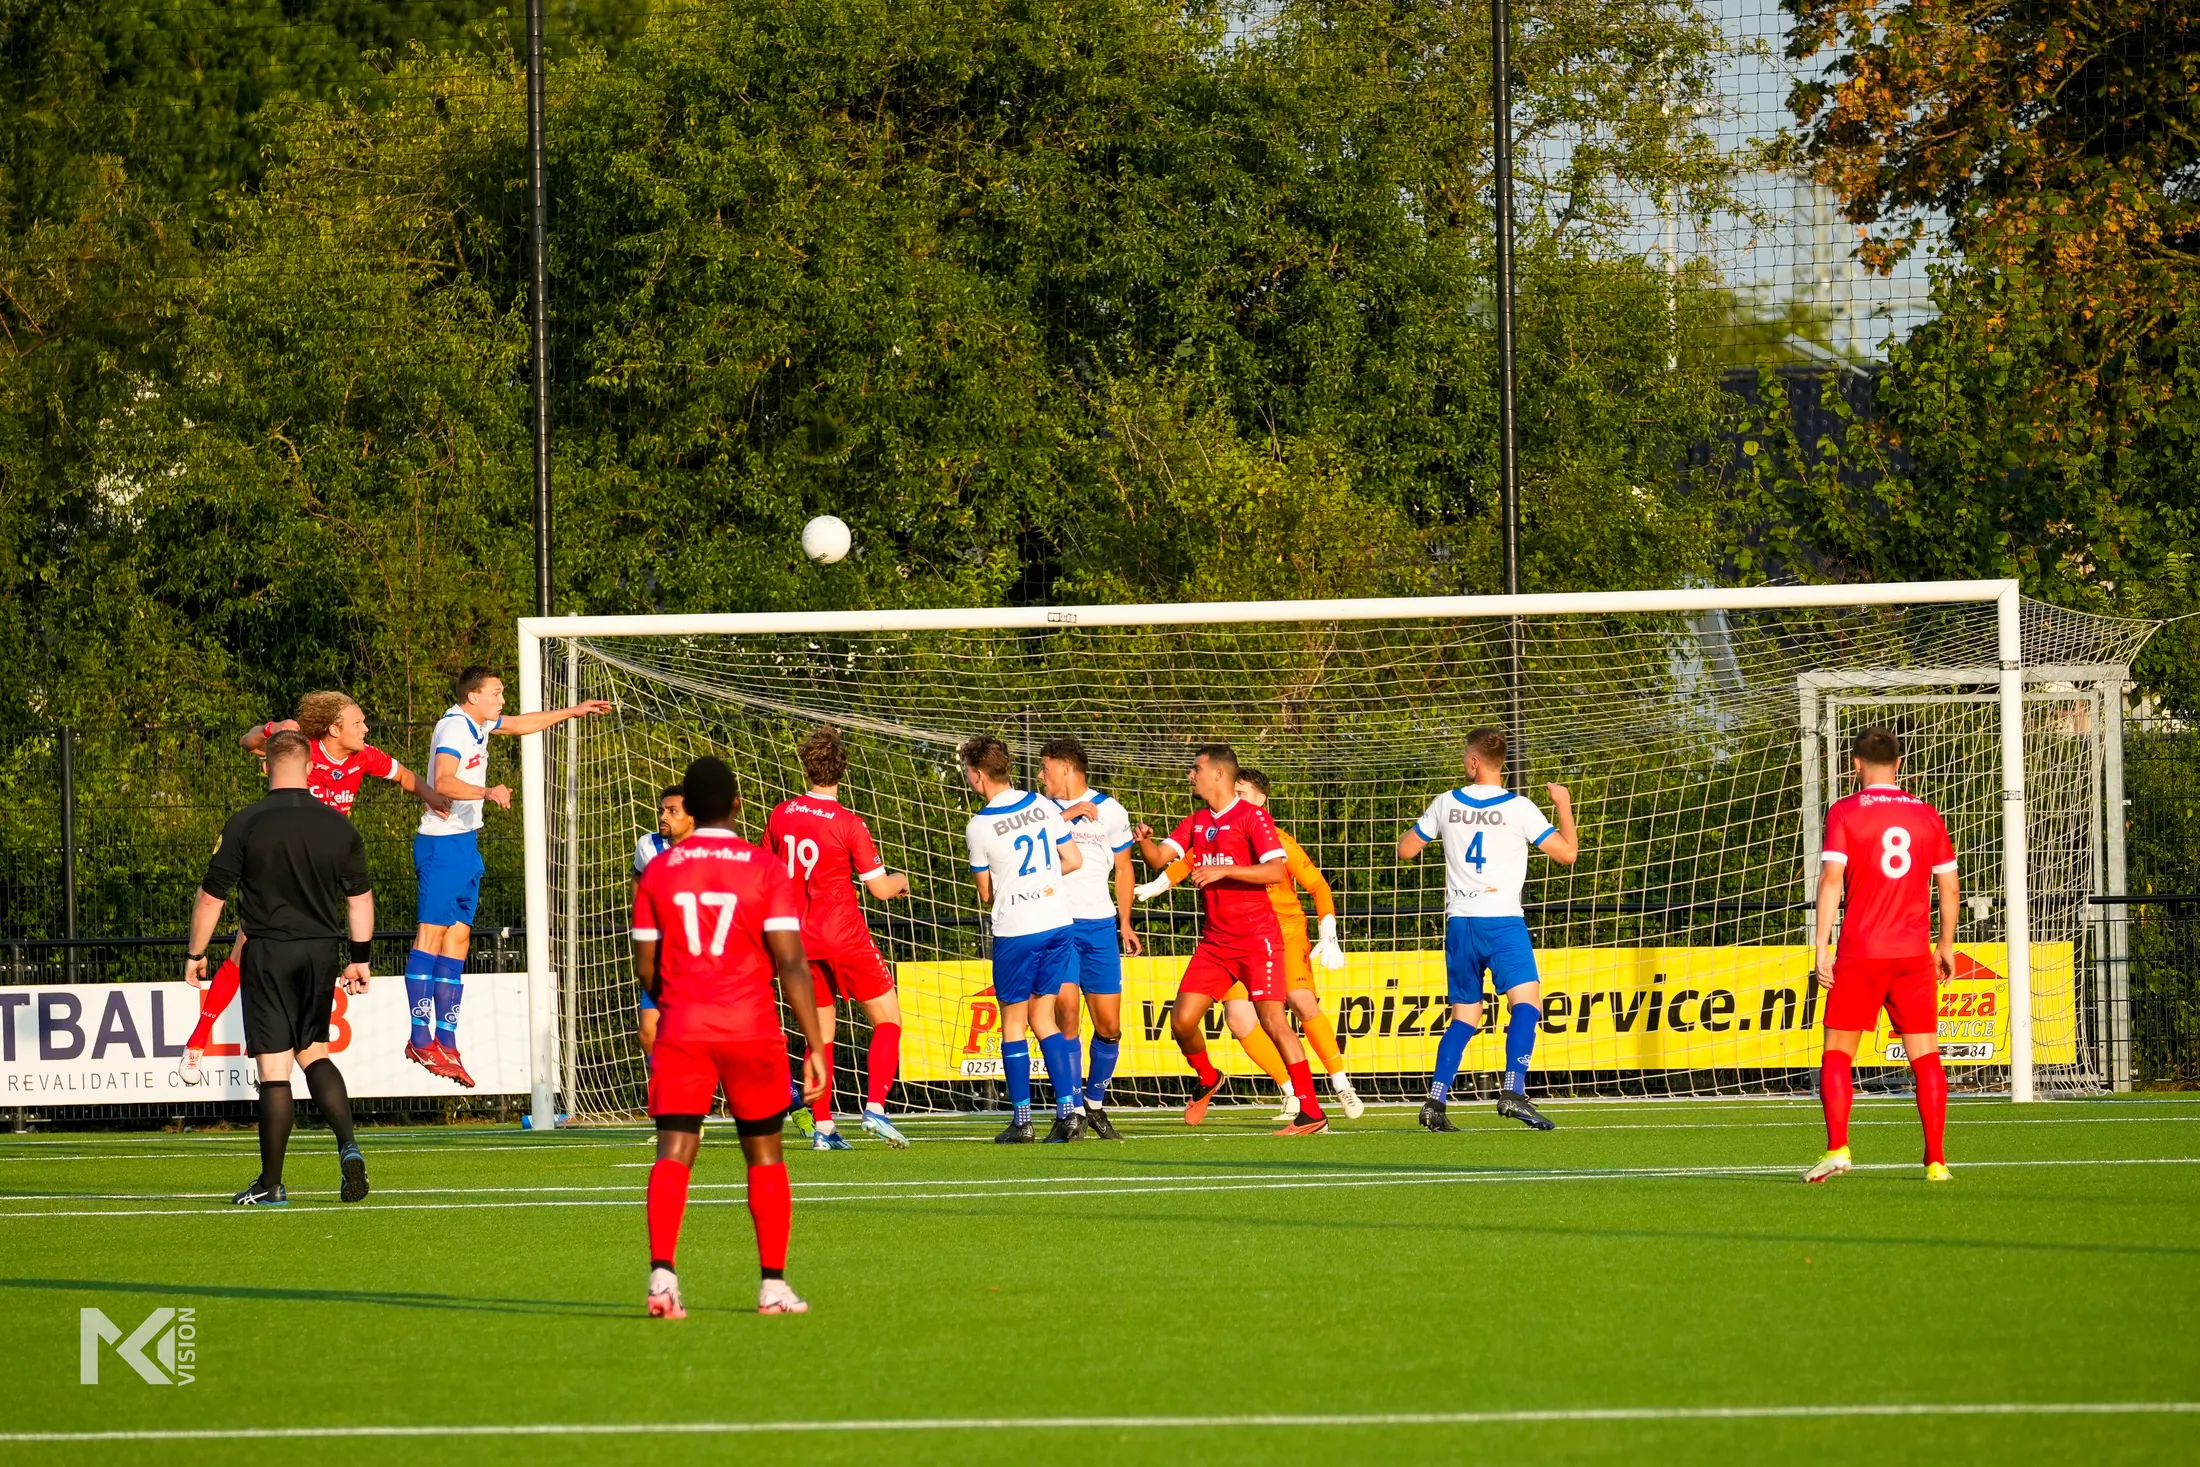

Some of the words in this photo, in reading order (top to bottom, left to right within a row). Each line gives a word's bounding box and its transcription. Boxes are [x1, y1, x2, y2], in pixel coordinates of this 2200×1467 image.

[795, 804, 835, 820] vdv-vh.nl
[684, 846, 751, 863] vdv-vh.nl
[783, 834, 819, 881] 19
[1014, 827, 1052, 877] 21
[1465, 831, 1487, 874] 4
[1881, 826, 1912, 879] 8
[1011, 888, 1041, 906] ING
[673, 891, 738, 957] 17
[1936, 1020, 1995, 1037] RVICE
[8, 1071, 154, 1092] REVALIDATIE
